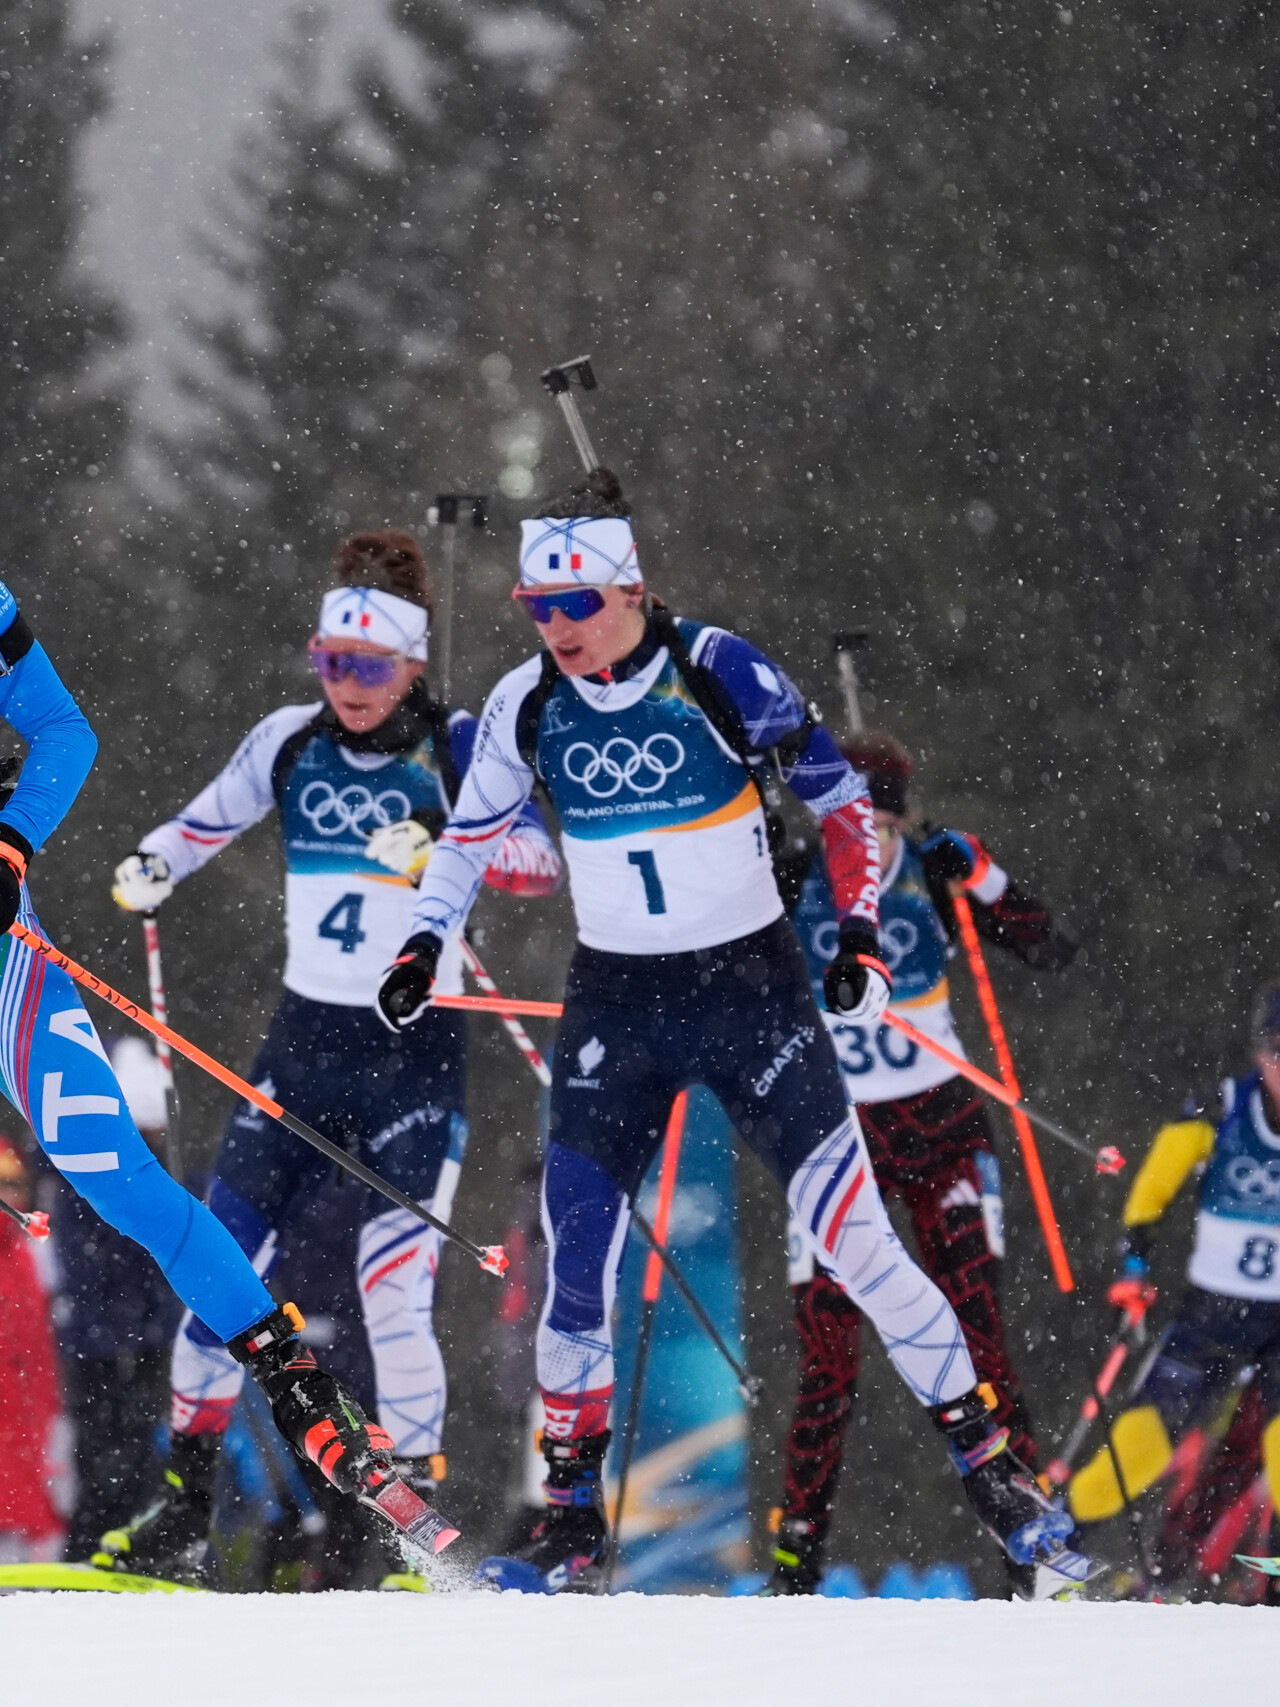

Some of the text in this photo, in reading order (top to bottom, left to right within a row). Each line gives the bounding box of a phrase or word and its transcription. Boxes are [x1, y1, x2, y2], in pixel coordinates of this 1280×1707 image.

[477, 706, 497, 763] CRAFT
[566, 794, 706, 817] MILANO CORTINA 2026
[753, 825, 764, 857] 1
[627, 849, 667, 915] 1
[318, 893, 366, 954] 4
[755, 1034, 805, 1097] CRAFT
[833, 1018, 919, 1075] 30
[42, 1008, 120, 1173] ITA
[568, 1077, 600, 1090] FRANCE
